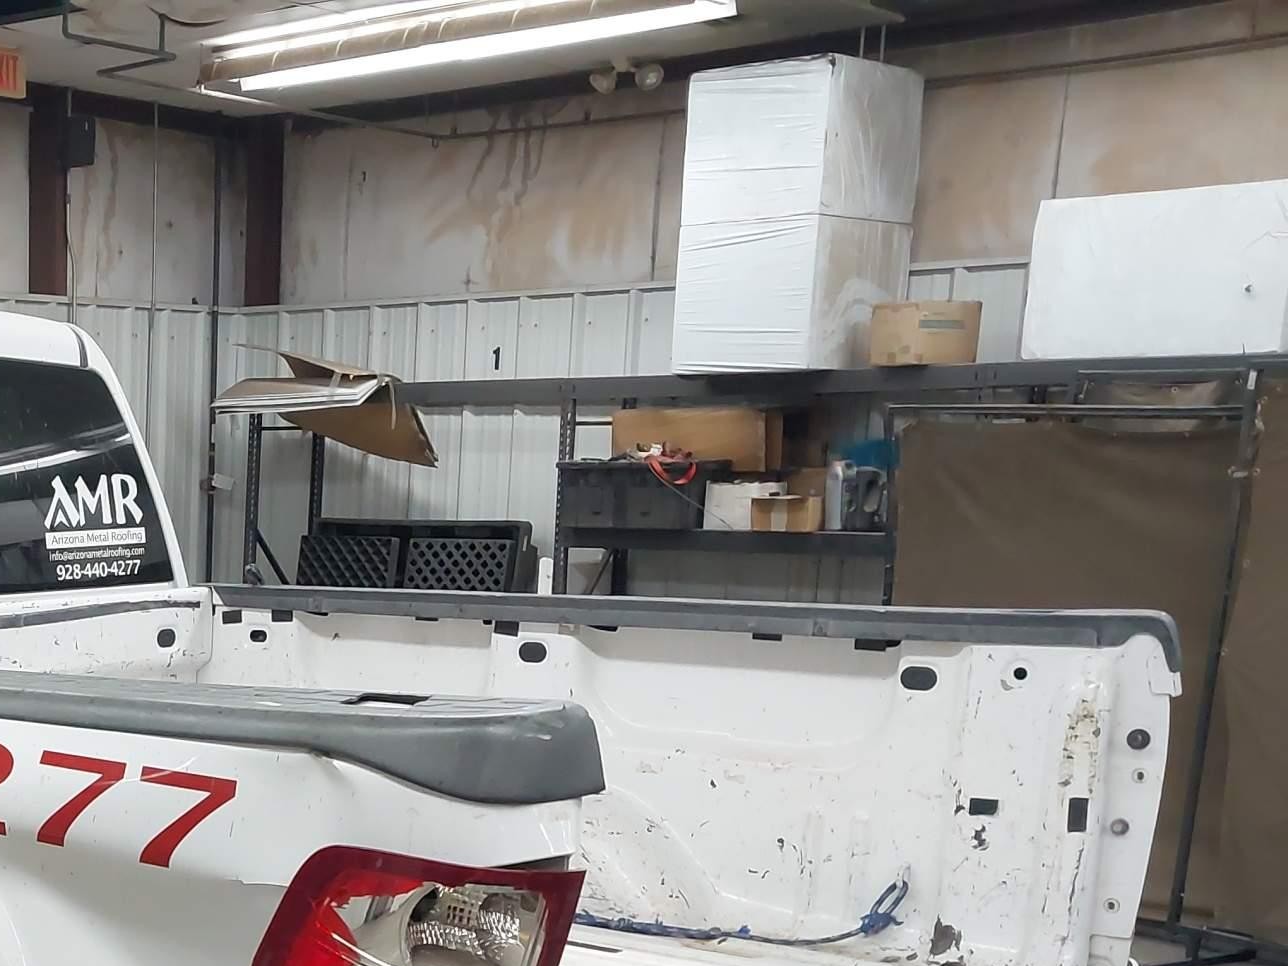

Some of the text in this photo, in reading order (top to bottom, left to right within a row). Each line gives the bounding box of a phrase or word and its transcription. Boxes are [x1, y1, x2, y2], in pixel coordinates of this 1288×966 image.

[492, 346, 501, 370] 1
[44, 473, 143, 529] AMR
[52, 530, 142, 545] Arizona Metal Roofing
[56, 560, 141, 580] 928-440-4277
